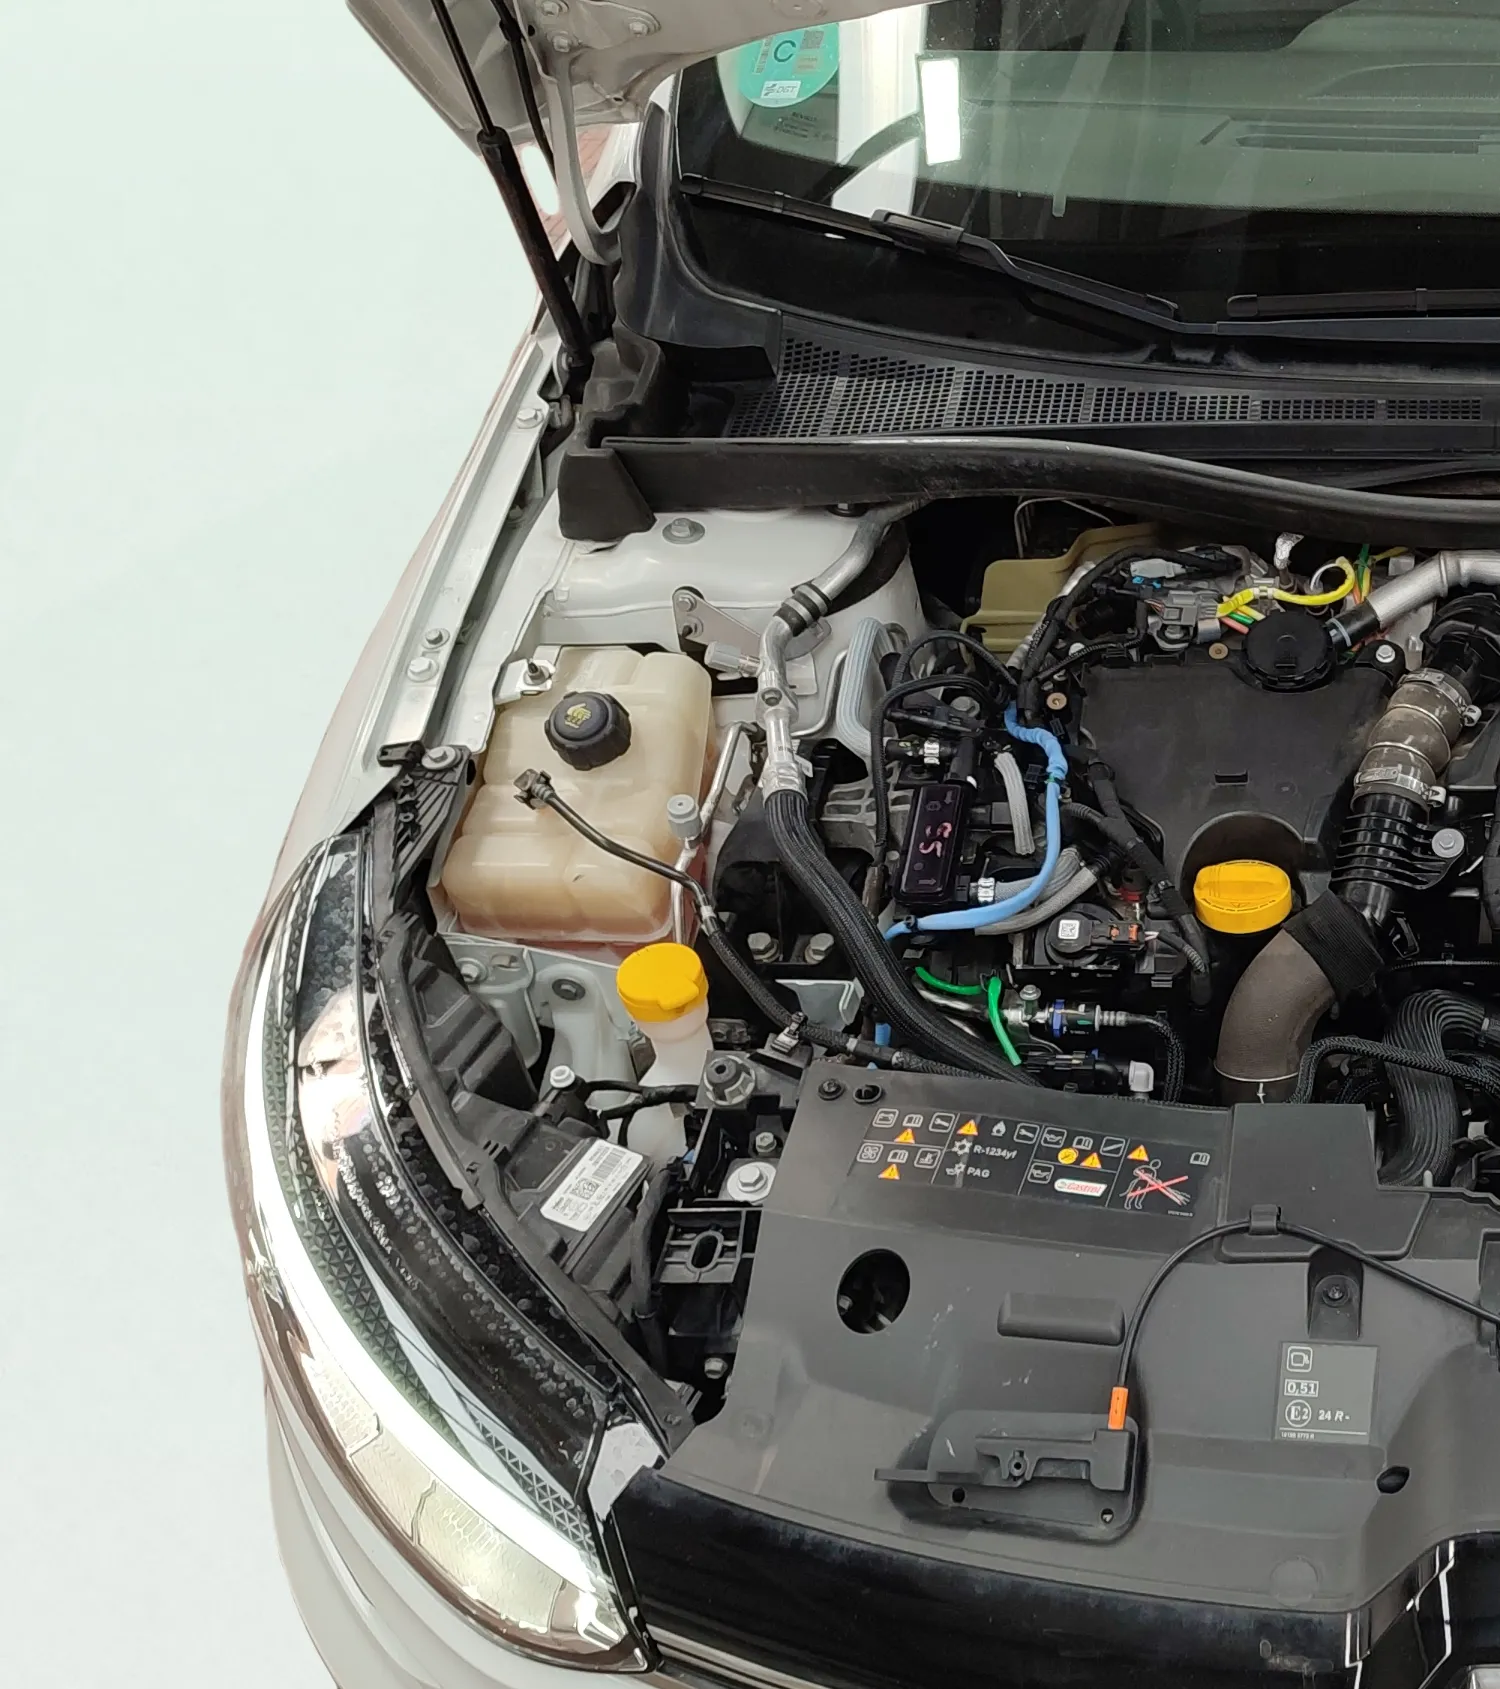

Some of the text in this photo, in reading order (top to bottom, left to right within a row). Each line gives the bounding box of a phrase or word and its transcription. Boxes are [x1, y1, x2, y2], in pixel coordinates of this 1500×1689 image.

[773, 39, 797, 63] C
[776, 85, 797, 94] DGT
[973, 1144, 1018, 1160] R-1234yf
[966, 1166, 991, 1179] PAG
[1066, 1182, 1102, 1194] Castrol
[1318, 1409, 1332, 1421] 24
